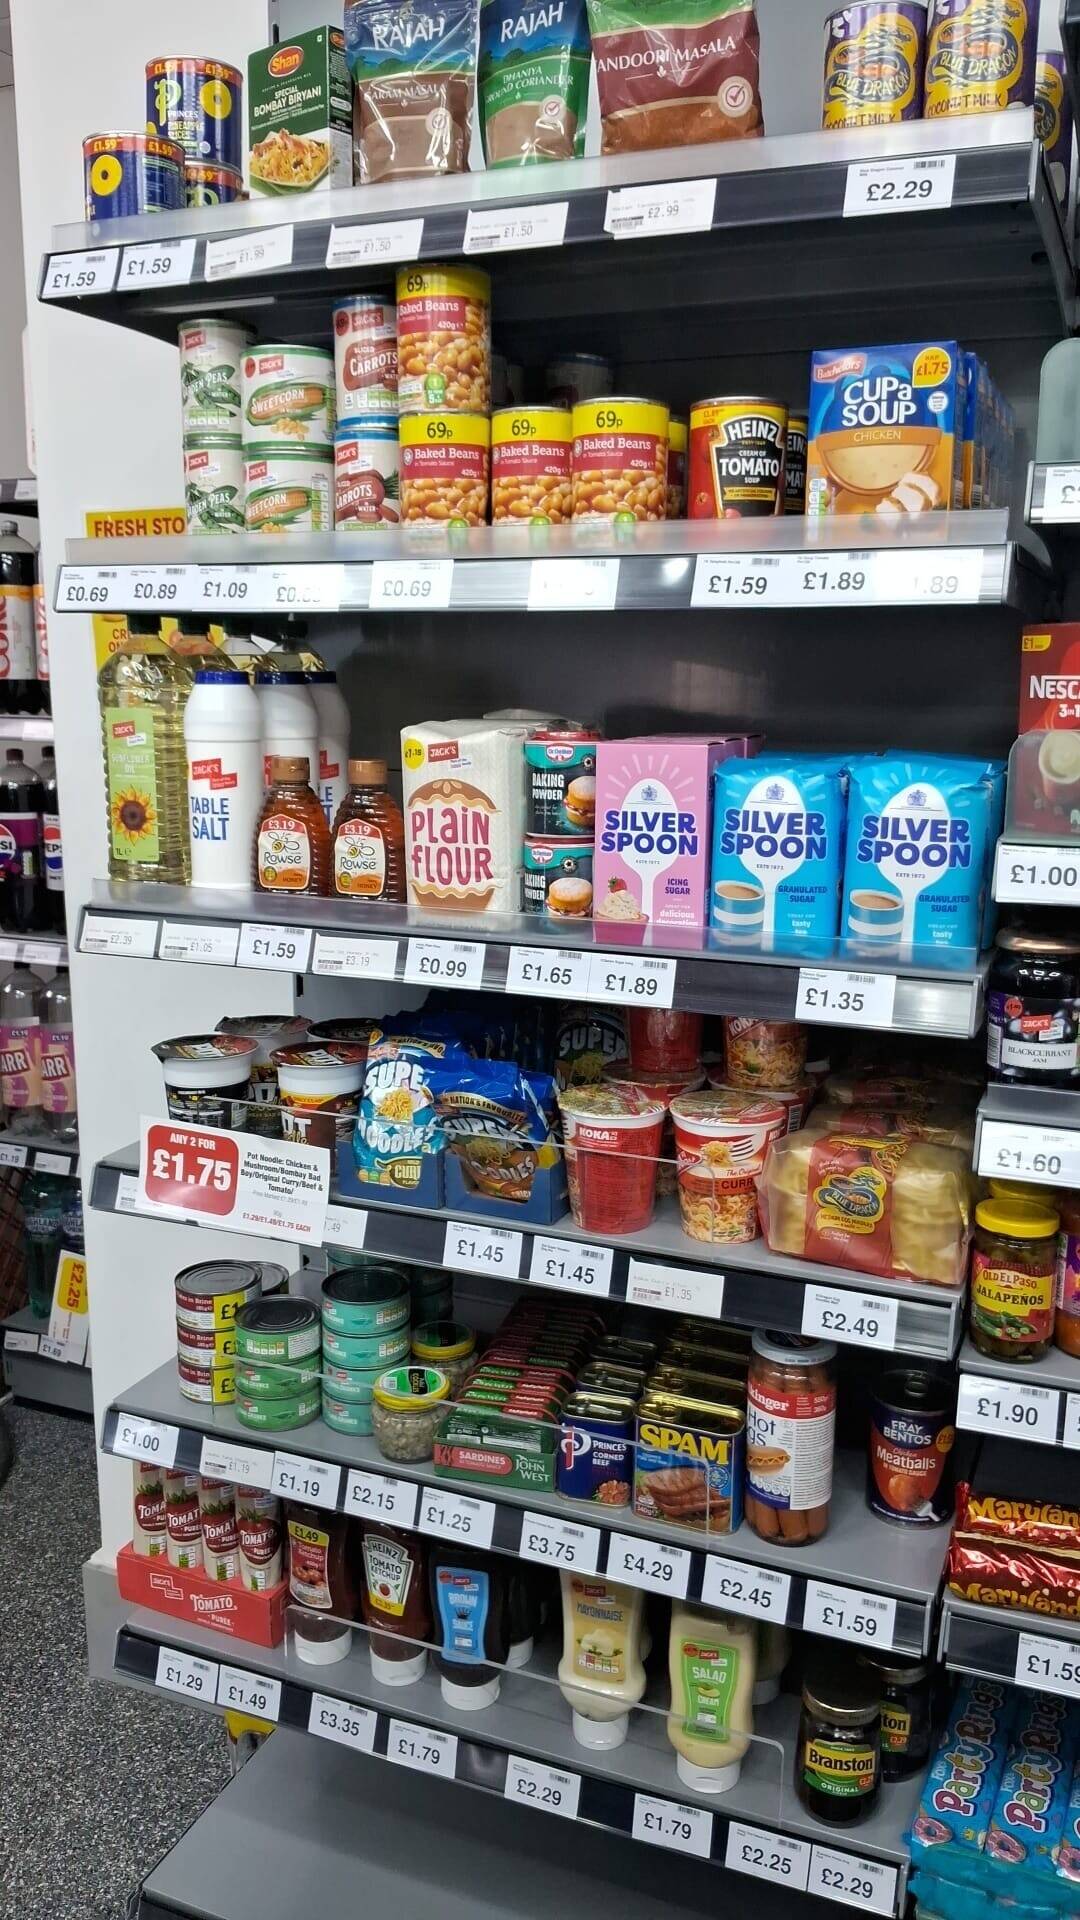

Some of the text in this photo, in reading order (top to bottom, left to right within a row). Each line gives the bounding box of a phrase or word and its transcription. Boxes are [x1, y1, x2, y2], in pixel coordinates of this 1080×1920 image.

[500, 2, 563, 43] RAJAH
[373, 16, 445, 50] RAJAH
[675, 35, 736, 62] MASALA
[271, 53, 299, 72] Shan
[940, 47, 1017, 75] BLUE DRAGON
[503, 66, 542, 84] DHANIYA
[863, 70, 909, 96] DRAGON
[254, 85, 321, 117] BOMBAY BIRYANI
[274, 85, 298, 100] SPECIAL
[94, 139, 117, 152] £1.59
[866, 180, 933, 202] £2.29
[648, 205, 679, 219] £2.99
[504, 225, 533, 238] £1.50
[364, 240, 391, 253] £1.50
[126, 258, 172, 276] £1.59
[52, 271, 96, 289] £1.59
[407, 275, 428, 292] 69p
[425, 300, 459, 312] Beans
[350, 351, 397, 376] CARROTS
[917, 362, 948, 376] £1.75
[206, 372, 228, 387] PEAS
[252, 388, 304, 415] SWEETCORN
[596, 411, 623, 428] 69p
[842, 401, 916, 426] SOUP
[427, 422, 453, 440] 69p
[511, 420, 536, 437] 69p
[728, 420, 777, 441] HEINZ
[854, 431, 901, 442] CHICKEN
[500, 446, 564, 457] Baked Beans
[583, 438, 651, 450] Baked Beans
[414, 449, 480, 460] Baked Beans
[630, 459, 647, 468] 420g
[720, 458, 779, 476] TOMATO
[208, 492, 231, 508] PEAS
[95, 517, 148, 537] FRESH
[382, 580, 432, 597] £0.69
[708, 576, 768, 595] £1.59
[803, 572, 866, 590] £1.89
[66, 586, 109, 602] £0.69
[134, 584, 177, 600] £0.89
[203, 582, 248, 599] £1.09
[430, 746, 456, 757] JACK'S
[192, 763, 220, 778] JACK'S
[532, 773, 564, 787] BAKING
[532, 789, 563, 800] POWDER
[191, 797, 230, 816] TABLE
[192, 817, 230, 841] SALT
[268, 820, 296, 830] £3.19
[344, 825, 371, 836] £3.19
[605, 811, 696, 833] SILVER
[725, 810, 825, 835] SILVER
[863, 815, 970, 842] SILVER
[601, 833, 699, 855] SPOON
[720, 832, 827, 860] SPOON
[264, 852, 302, 864] Rowse
[857, 840, 971, 867] SPOON
[340, 857, 376, 870] Rowse
[667, 878, 688, 886] ICING
[1010, 865, 1077, 886] £1.00
[665, 887, 690, 895] SUGAR
[778, 885, 827, 894] GRANULATED
[790, 895, 815, 903] SUGAR
[919, 895, 970, 903] GRANULATED
[660, 910, 694, 918] delicious
[931, 904, 958, 913] SUGAR
[792, 920, 811, 928] tasty
[110, 935, 132, 945] £2.39
[932, 931, 952, 939] tasty
[253, 940, 296, 959] £1.59
[345, 956, 370, 967] £3.19
[419, 957, 467, 977] £0.99
[522, 964, 572, 985] £1.65
[605, 974, 658, 995] £1.89
[805, 987, 865, 1012] £1.35
[1008, 1045, 1072, 1057] BLACKCURRANT
[170, 1133, 216, 1150] ANY 2 FOR
[579, 1127, 609, 1140] KOKA
[152, 1148, 232, 1191] £1.75
[247, 1152, 258, 1160] Pot
[260, 1155, 283, 1164] Noodle:
[285, 1159, 312, 1170] Chicken
[998, 1147, 1062, 1176] £1.60
[244, 1160, 320, 1181] Mushroom/Bombay Bad
[268, 1184, 294, 1195] Tomato/
[282, 1178, 316, 1191] Curry/Beef
[296, 1224, 311, 1232] EACH
[457, 1240, 503, 1262] £1.45
[545, 1260, 595, 1284] £1.45
[983, 1270, 999, 1281] OLD
[67, 1263, 84, 1307] £2.25
[664, 1287, 692, 1300] £1.35
[977, 1284, 1044, 1305] JALAPEÑOS
[822, 1311, 879, 1337] £2.49
[748, 1407, 776, 1435] Hot
[977, 1398, 1038, 1426] £1.90
[884, 1427, 932, 1445] BENTOS
[892, 1420, 923, 1434] FRAY
[122, 1428, 160, 1451] £1.00
[592, 1440, 627, 1452] PRINCES
[640, 1423, 729, 1464] SPAM
[459, 1451, 506, 1465] SARDINES
[592, 1451, 624, 1461] CORNED
[592, 1458, 610, 1467] BEEF
[877, 1445, 936, 1470] Meatballs
[228, 1461, 250, 1473] £1.19
[515, 1460, 545, 1473] JOHN
[279, 1473, 320, 1496] £1.19
[520, 1470, 551, 1483] WEST
[352, 1486, 394, 1511] £2.15
[427, 1506, 472, 1533] £1.25
[240, 1528, 274, 1545] TOMATO
[295, 1526, 319, 1542] £1.49
[372, 1543, 399, 1559] HEINZ
[528, 1535, 576, 1562] £3.75
[370, 1555, 402, 1574] TOMATO
[371, 1564, 400, 1580] KETCHUP
[623, 1554, 673, 1581] £4.29
[190, 1594, 233, 1611] TOMATO
[720, 1579, 772, 1608] £2.45
[211, 1615, 231, 1625] PUREE
[822, 1607, 877, 1636] £1.59
[166, 1668, 203, 1691] £1.29
[692, 1667, 727, 1683] SALAD
[229, 1687, 266, 1710] £1.49
[320, 1710, 360, 1737] £3.35
[398, 1739, 441, 1764] £1.79
[933, 1680, 1004, 1816] Party Rings
[809, 1750, 873, 1772] Branston
[517, 1779, 562, 1806] £2.29
[821, 1782, 859, 1794] ORIGINAL
[1003, 1754, 1062, 1833] Party
[644, 1813, 692, 1840] £1.79
[741, 1845, 792, 1875] £2.25
[821, 1868, 873, 1898] £2.29
